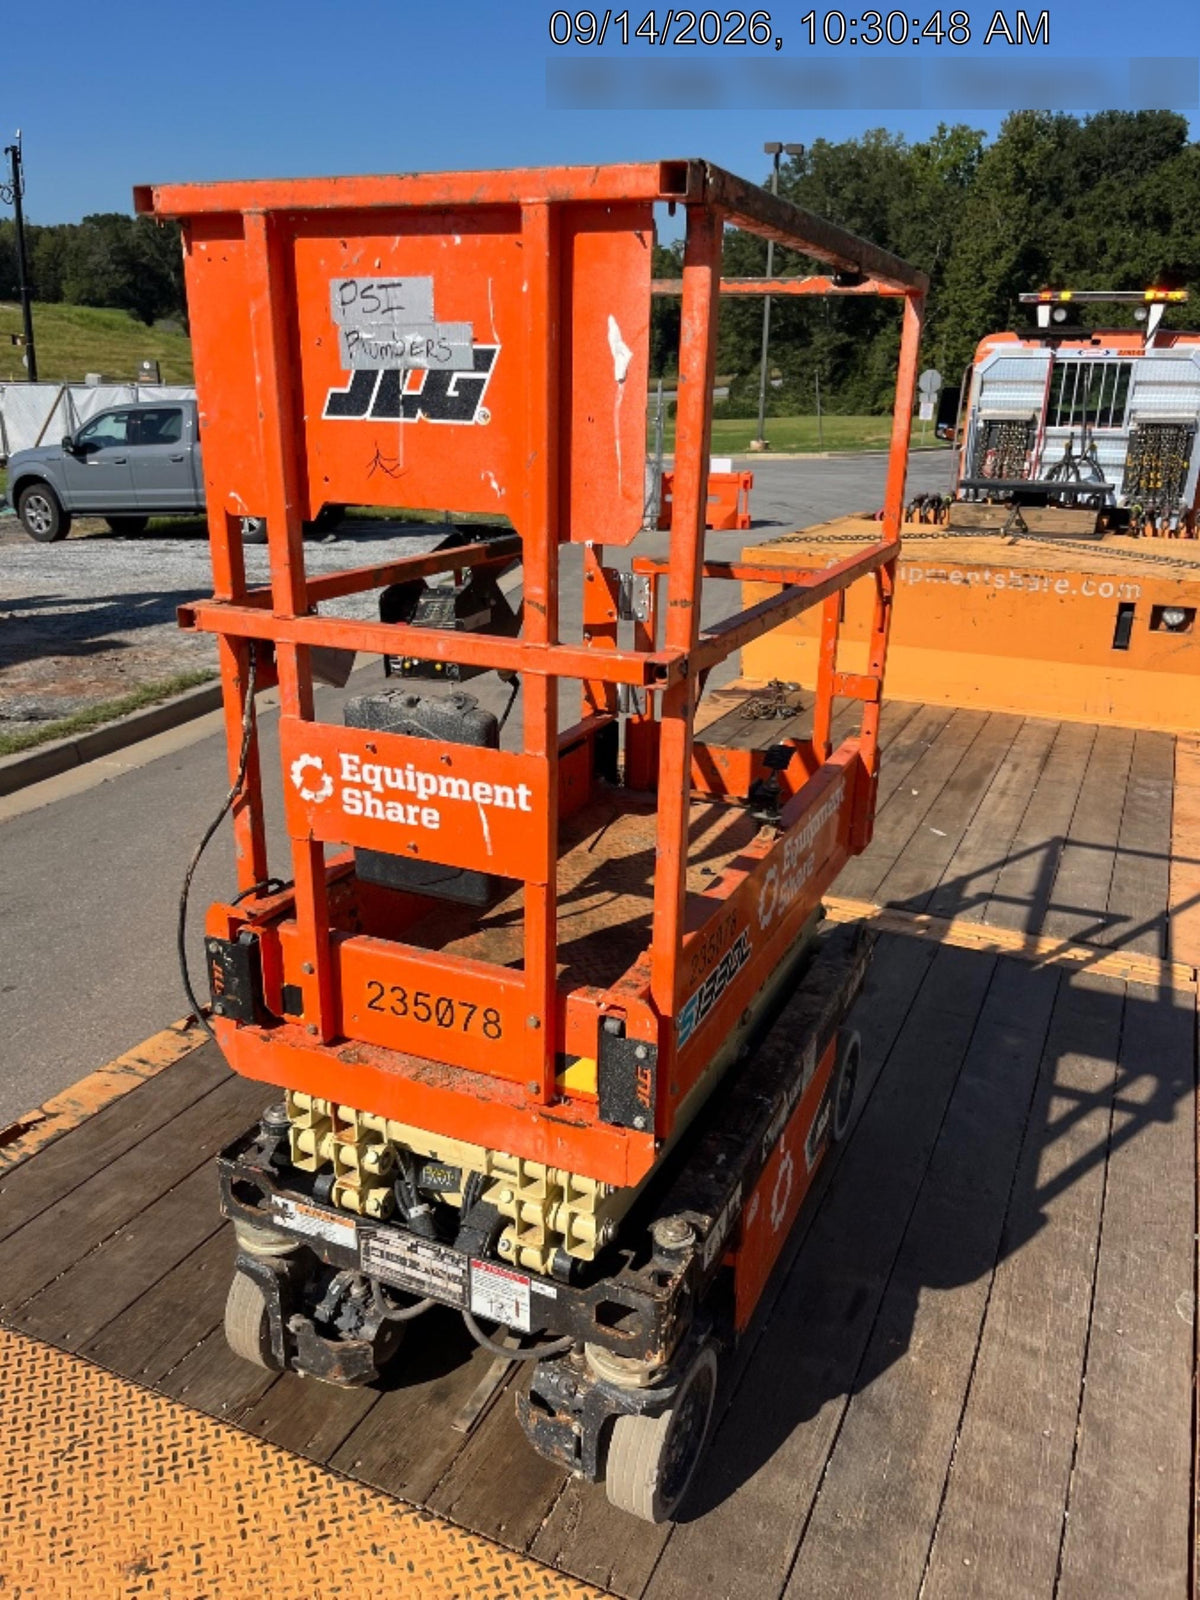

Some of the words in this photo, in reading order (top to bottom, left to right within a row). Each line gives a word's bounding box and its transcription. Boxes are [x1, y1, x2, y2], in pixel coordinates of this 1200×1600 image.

[339, 280, 404, 315] PSI
[338, 753, 532, 811] Equipment
[341, 787, 440, 829] Share
[782, 786, 846, 877] Equipment
[776, 852, 817, 917] Share
[366, 980, 502, 1039] 235078
[636, 1064, 652, 1109] JLG
